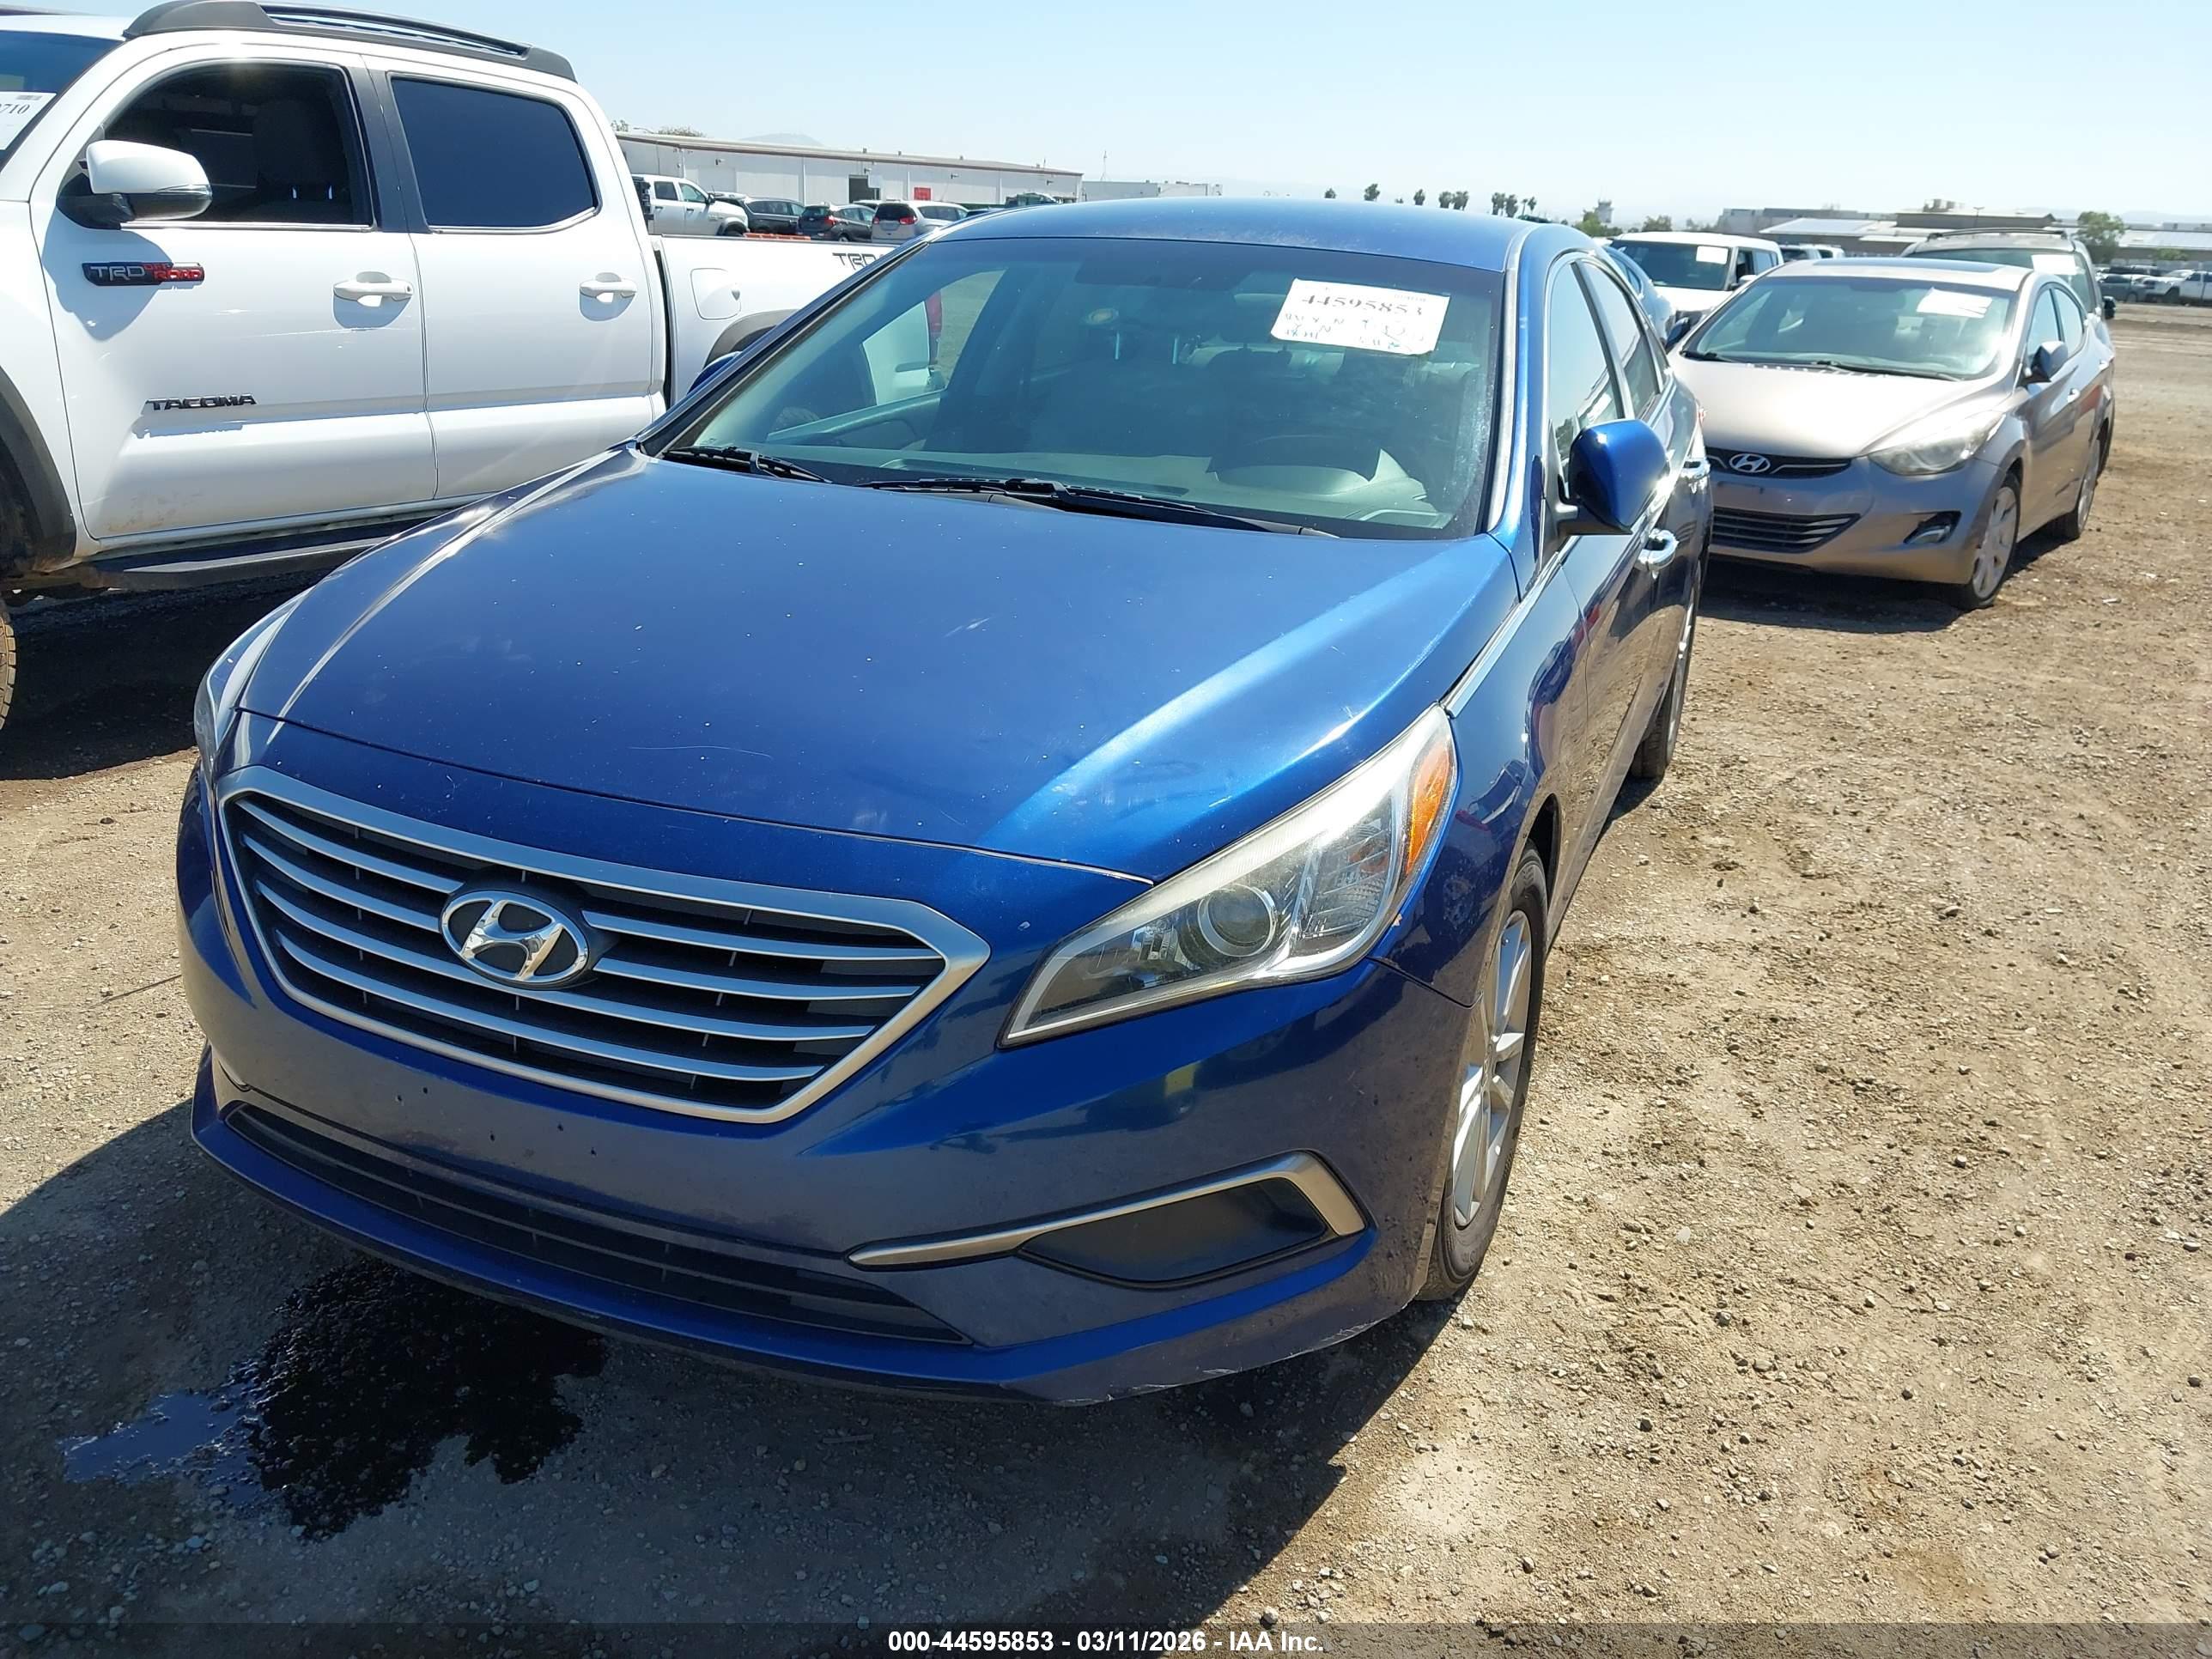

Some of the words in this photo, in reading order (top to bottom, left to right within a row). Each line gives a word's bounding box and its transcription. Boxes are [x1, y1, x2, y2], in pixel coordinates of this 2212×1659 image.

[0, 103, 30, 114] 710
[90, 265, 144, 282] TRD
[154, 269, 202, 280] ROAD
[145, 393, 257, 410] TACOMA
